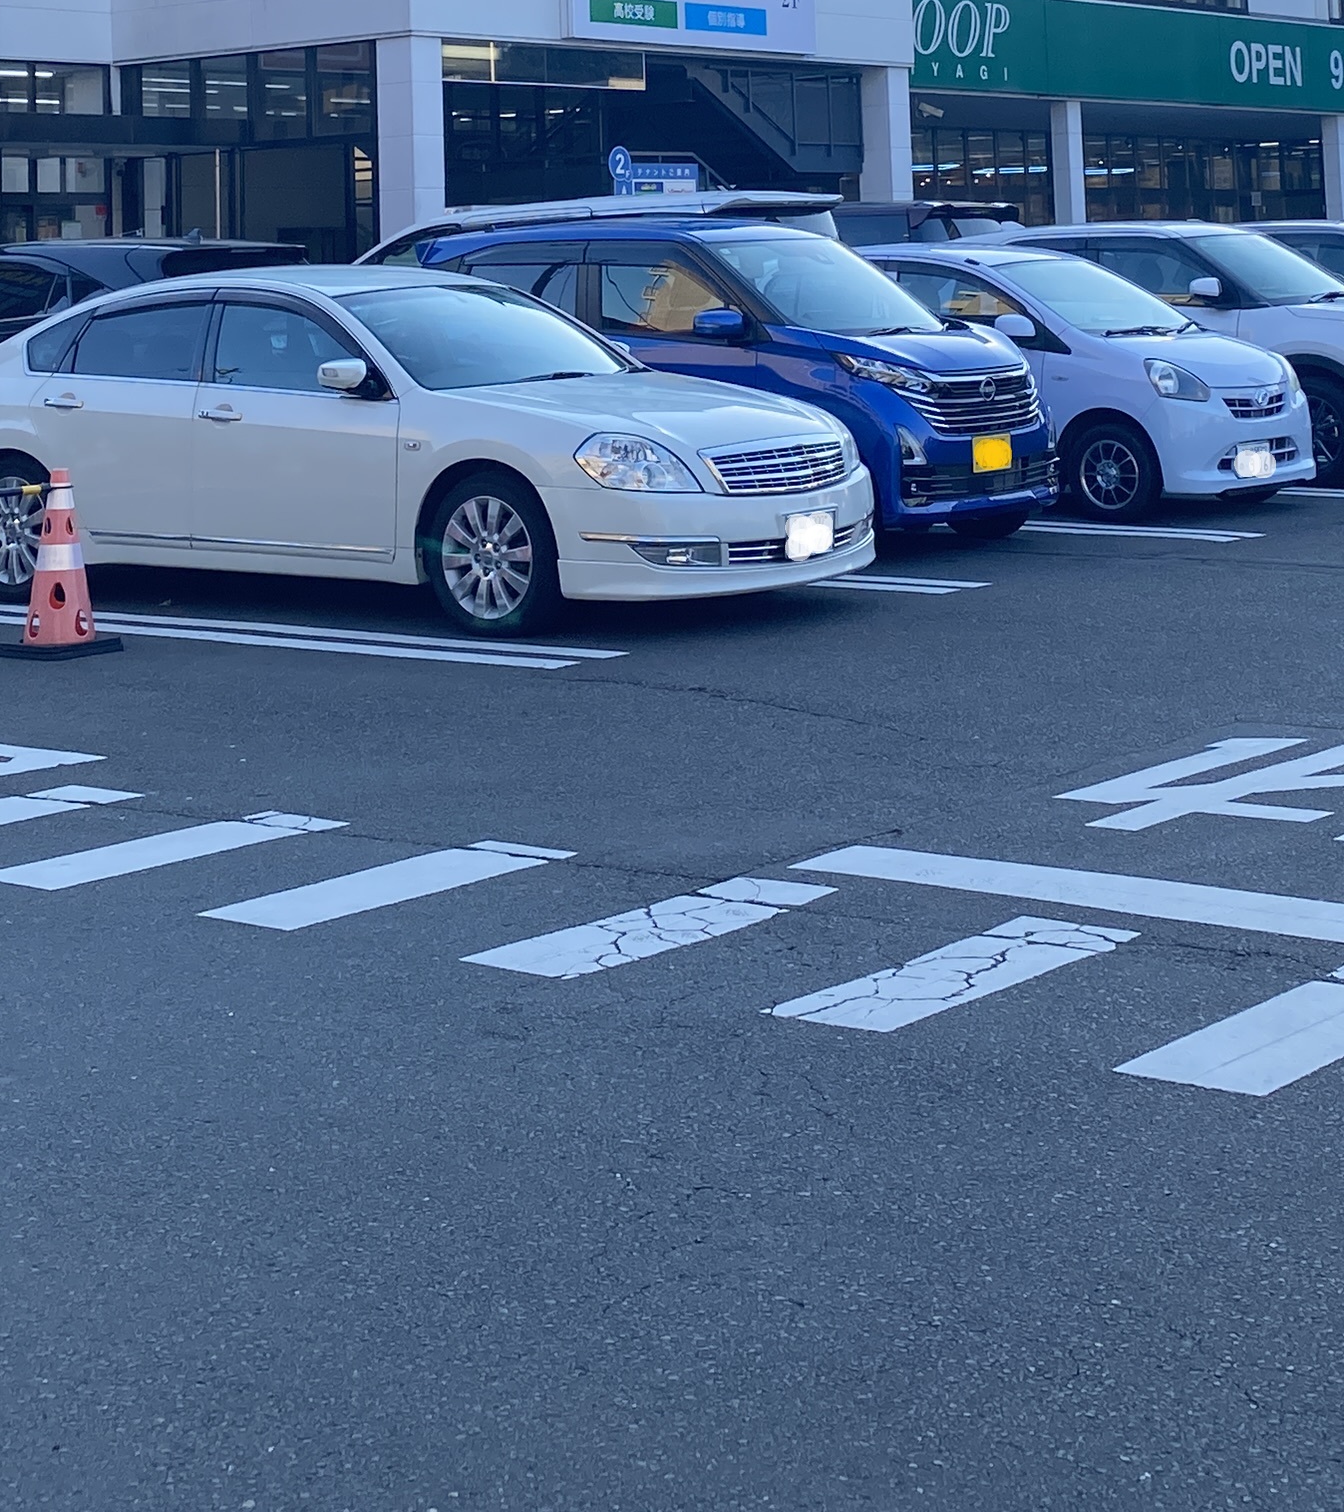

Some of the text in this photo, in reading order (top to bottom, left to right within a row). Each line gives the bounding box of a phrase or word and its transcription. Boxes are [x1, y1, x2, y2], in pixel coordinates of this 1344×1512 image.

[613, 2, 655, 22] 高校受験
[707, 11, 746, 29] 個別指導
[911, 62, 1008, 81] IYAGI
[1229, 39, 1303, 88] OPEN
